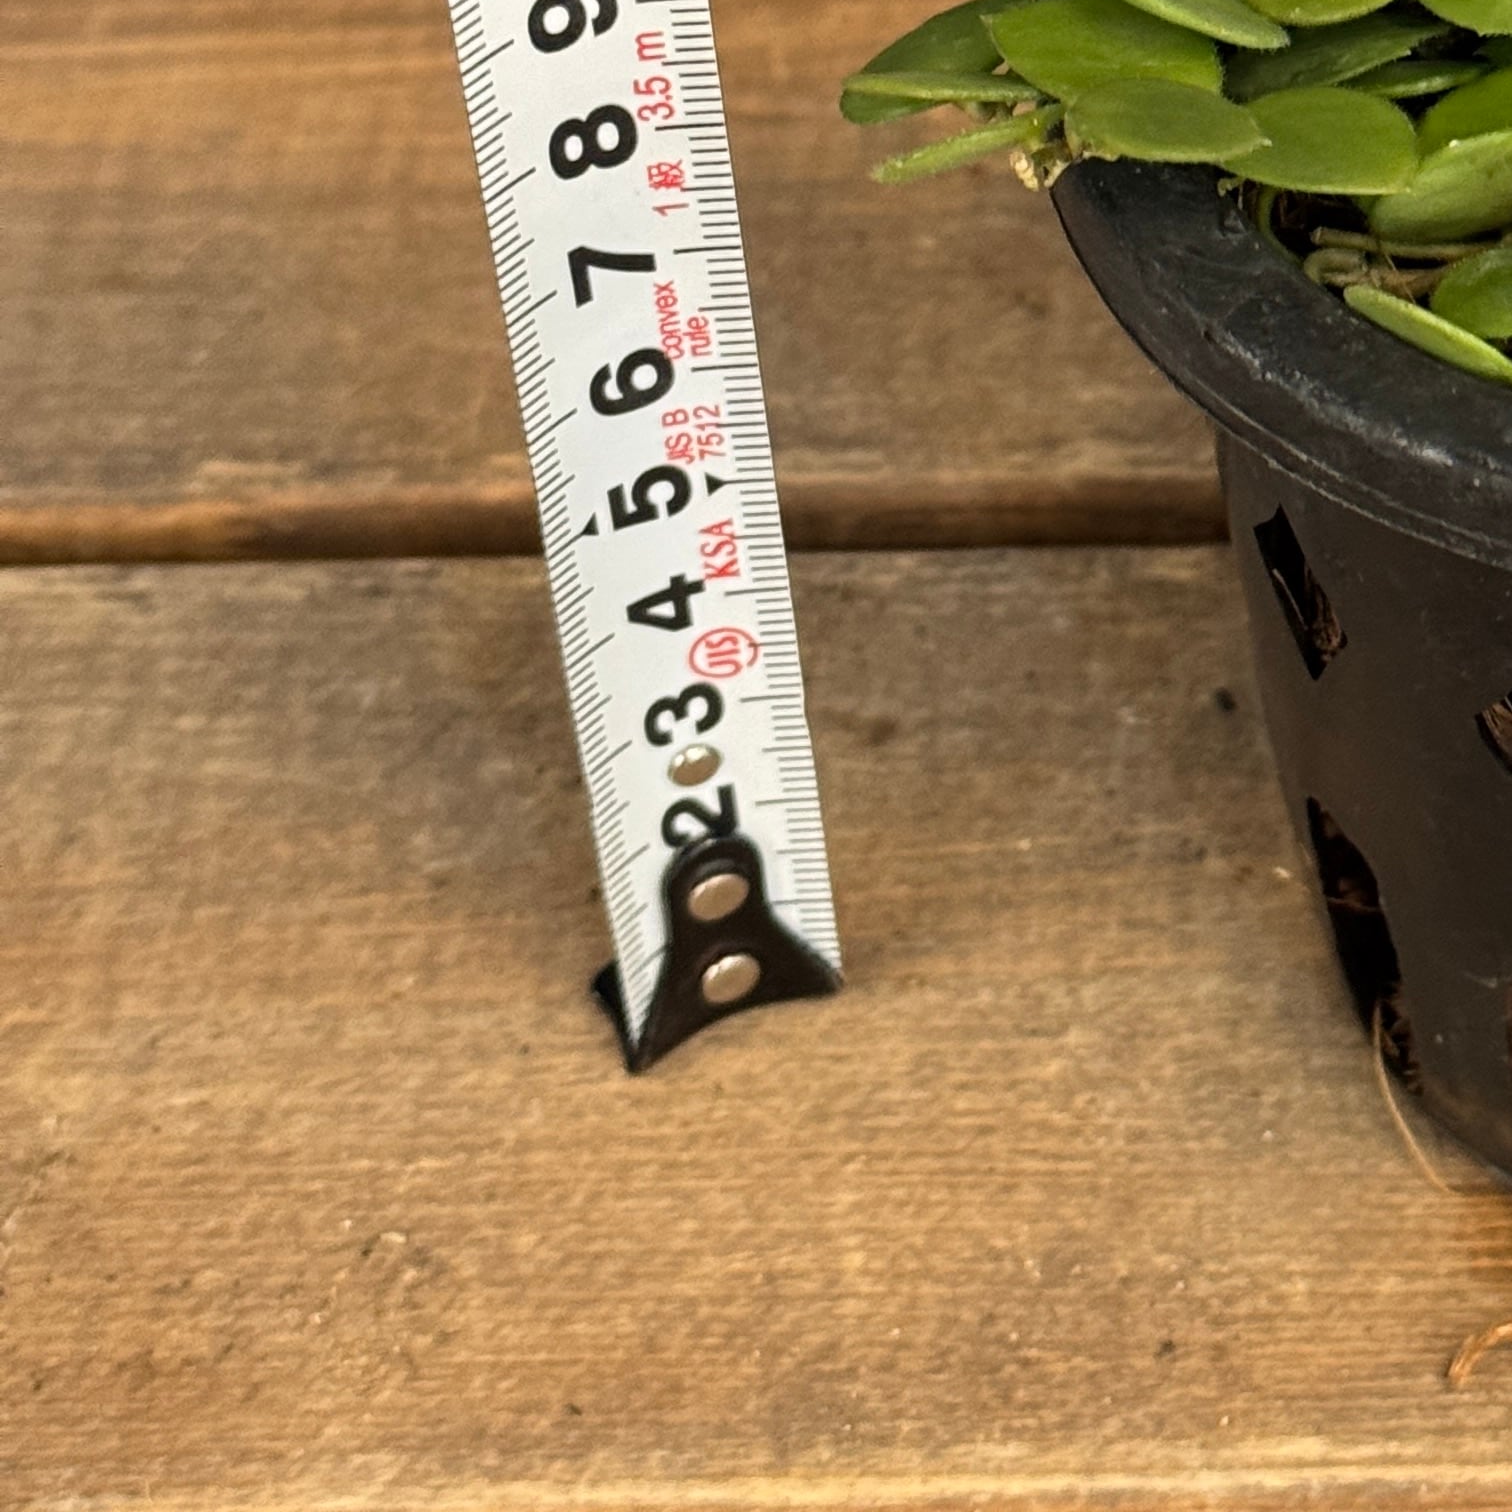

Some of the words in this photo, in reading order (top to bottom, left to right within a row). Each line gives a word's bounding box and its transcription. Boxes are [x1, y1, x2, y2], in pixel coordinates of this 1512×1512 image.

[634, 30, 667, 62] m
[632, 75, 676, 122] 3.5
[548, 103, 639, 181] 8
[567, 245, 657, 309] 7
[653, 279, 685, 361] convex
[685, 315, 713, 358] rule
[588, 346, 676, 417] 6
[661, 407, 691, 427] B
[692, 403, 727, 462] 7512
[606, 463, 693, 532] 5
[698, 517, 743, 582] KSA
[625, 572, 706, 632] 4
[643, 681, 725, 748] 3
[660, 782, 740, 849] 2
